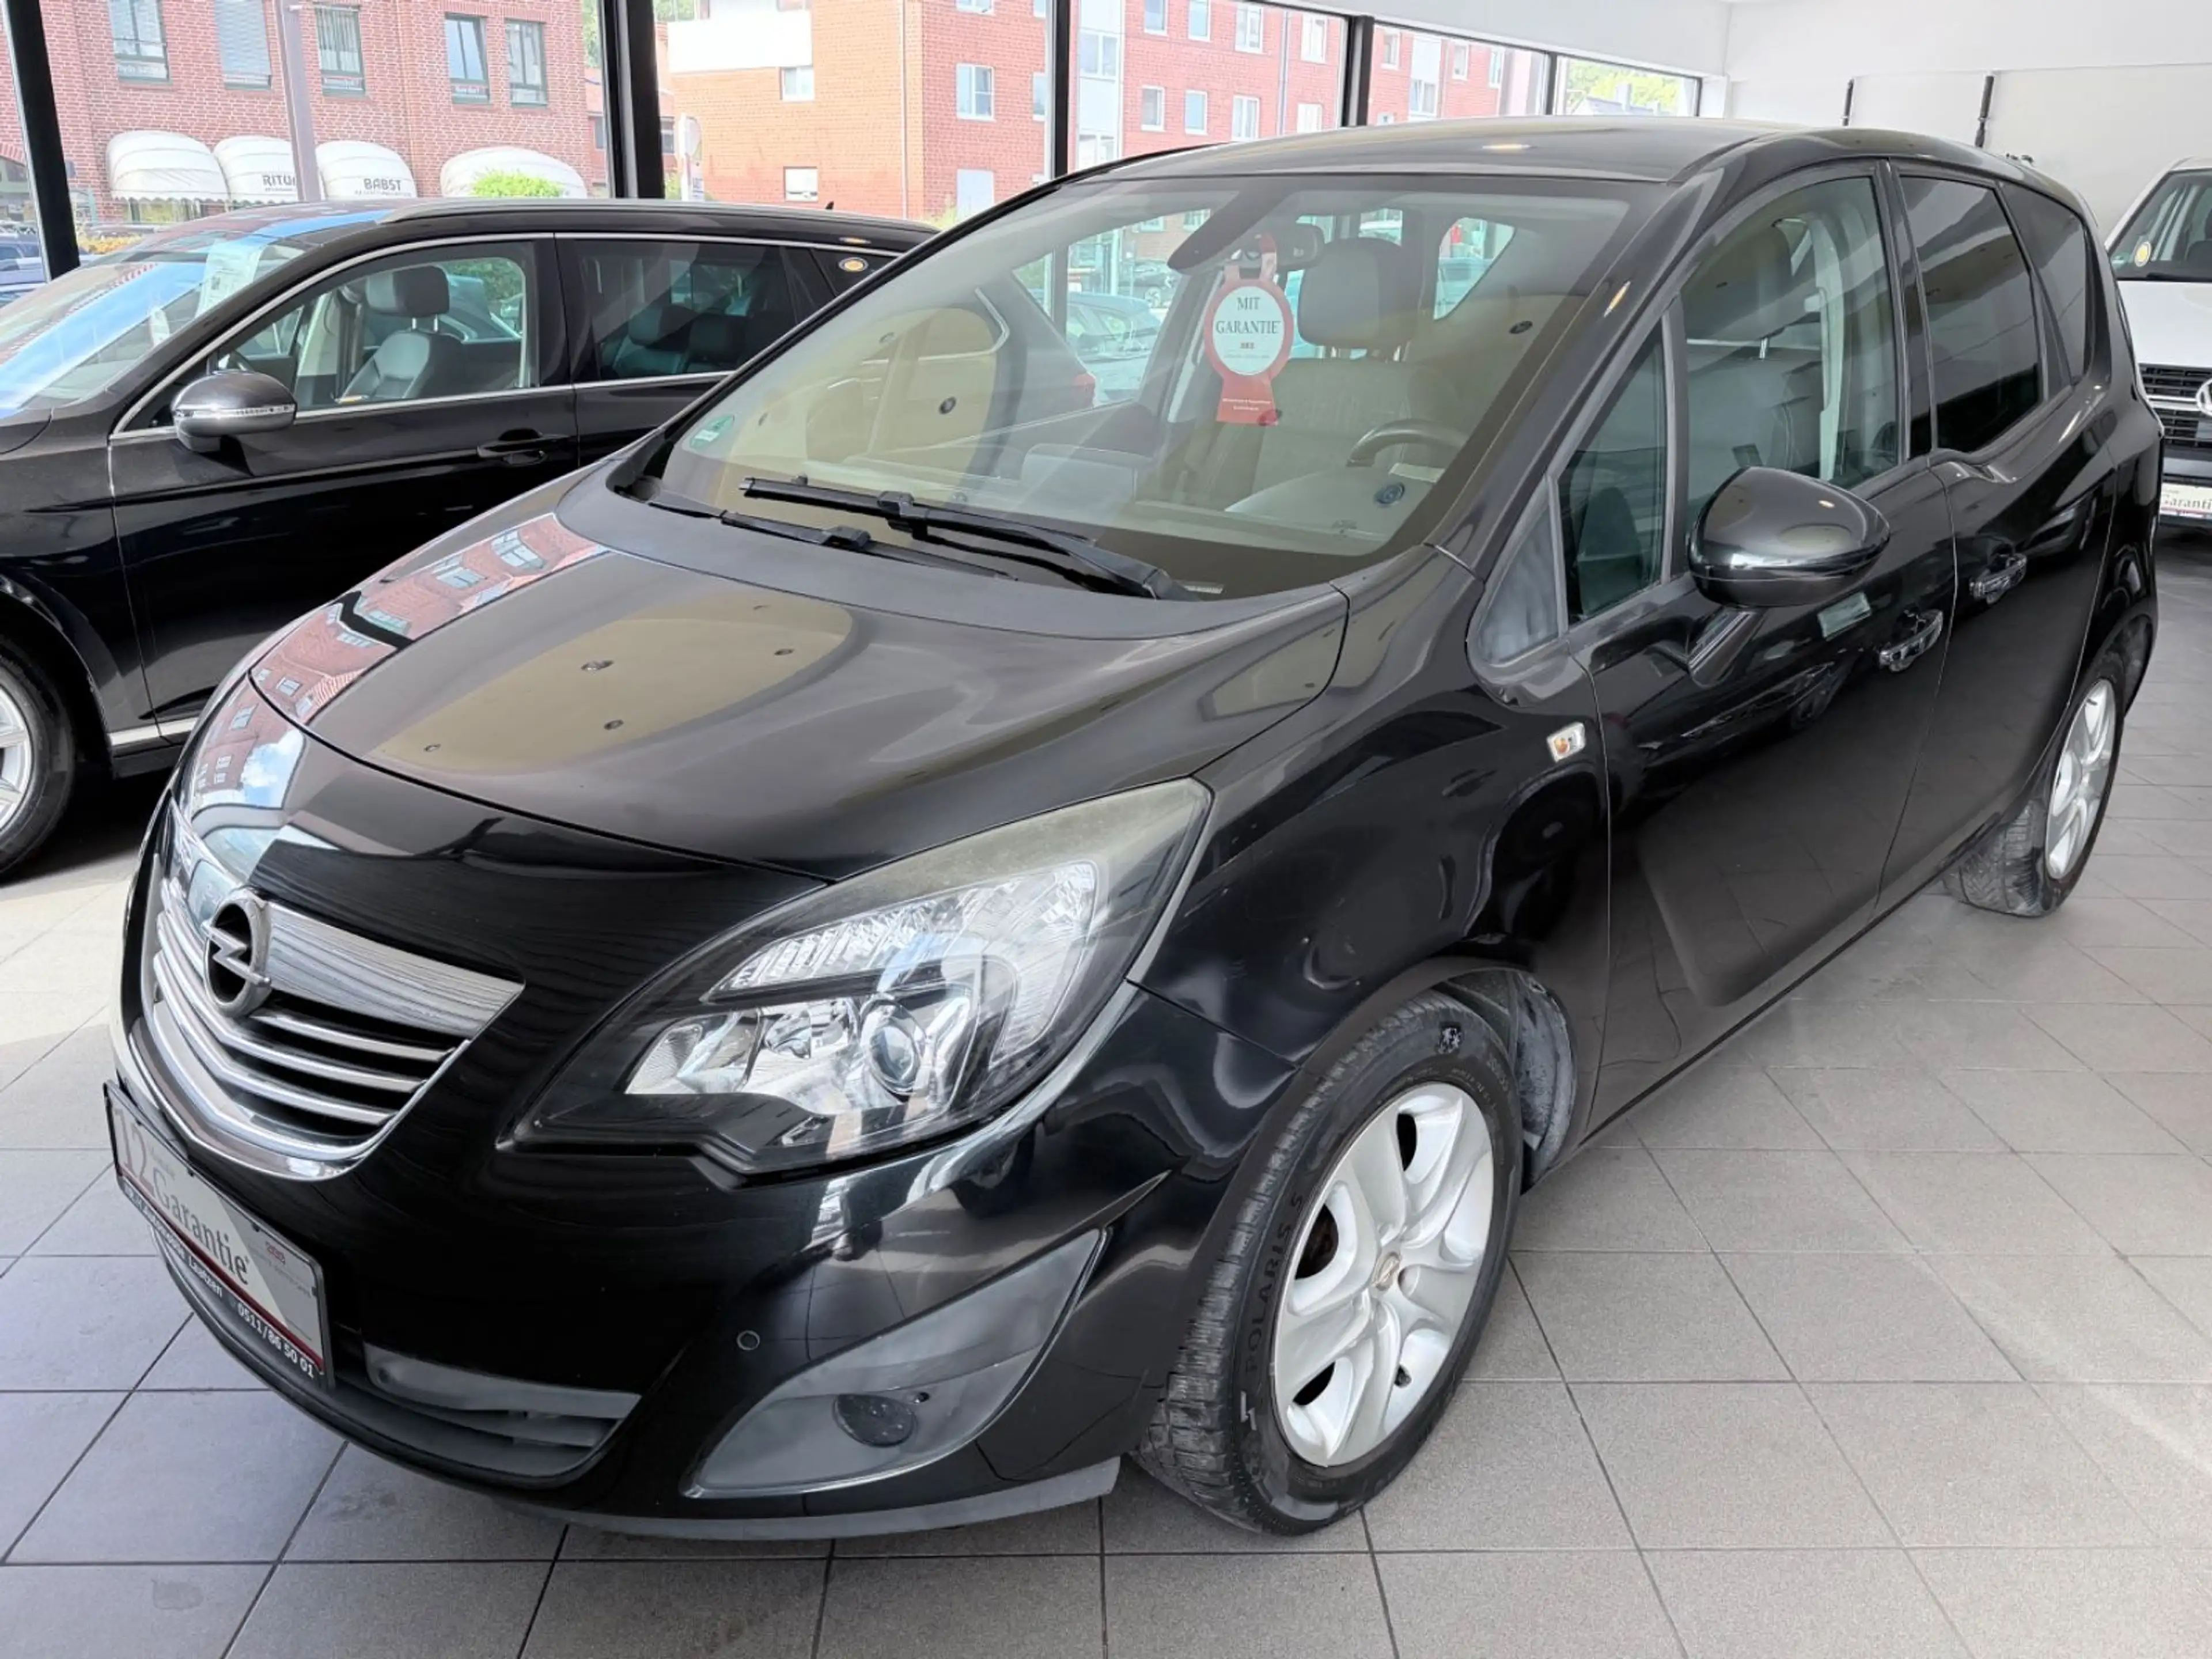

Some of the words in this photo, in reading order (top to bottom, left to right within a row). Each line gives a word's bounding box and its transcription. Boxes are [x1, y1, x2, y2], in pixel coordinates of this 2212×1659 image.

[363, 177, 402, 191] BABST
[1237, 297, 1260, 310] MIT
[1215, 320, 1281, 334] GARANTIE
